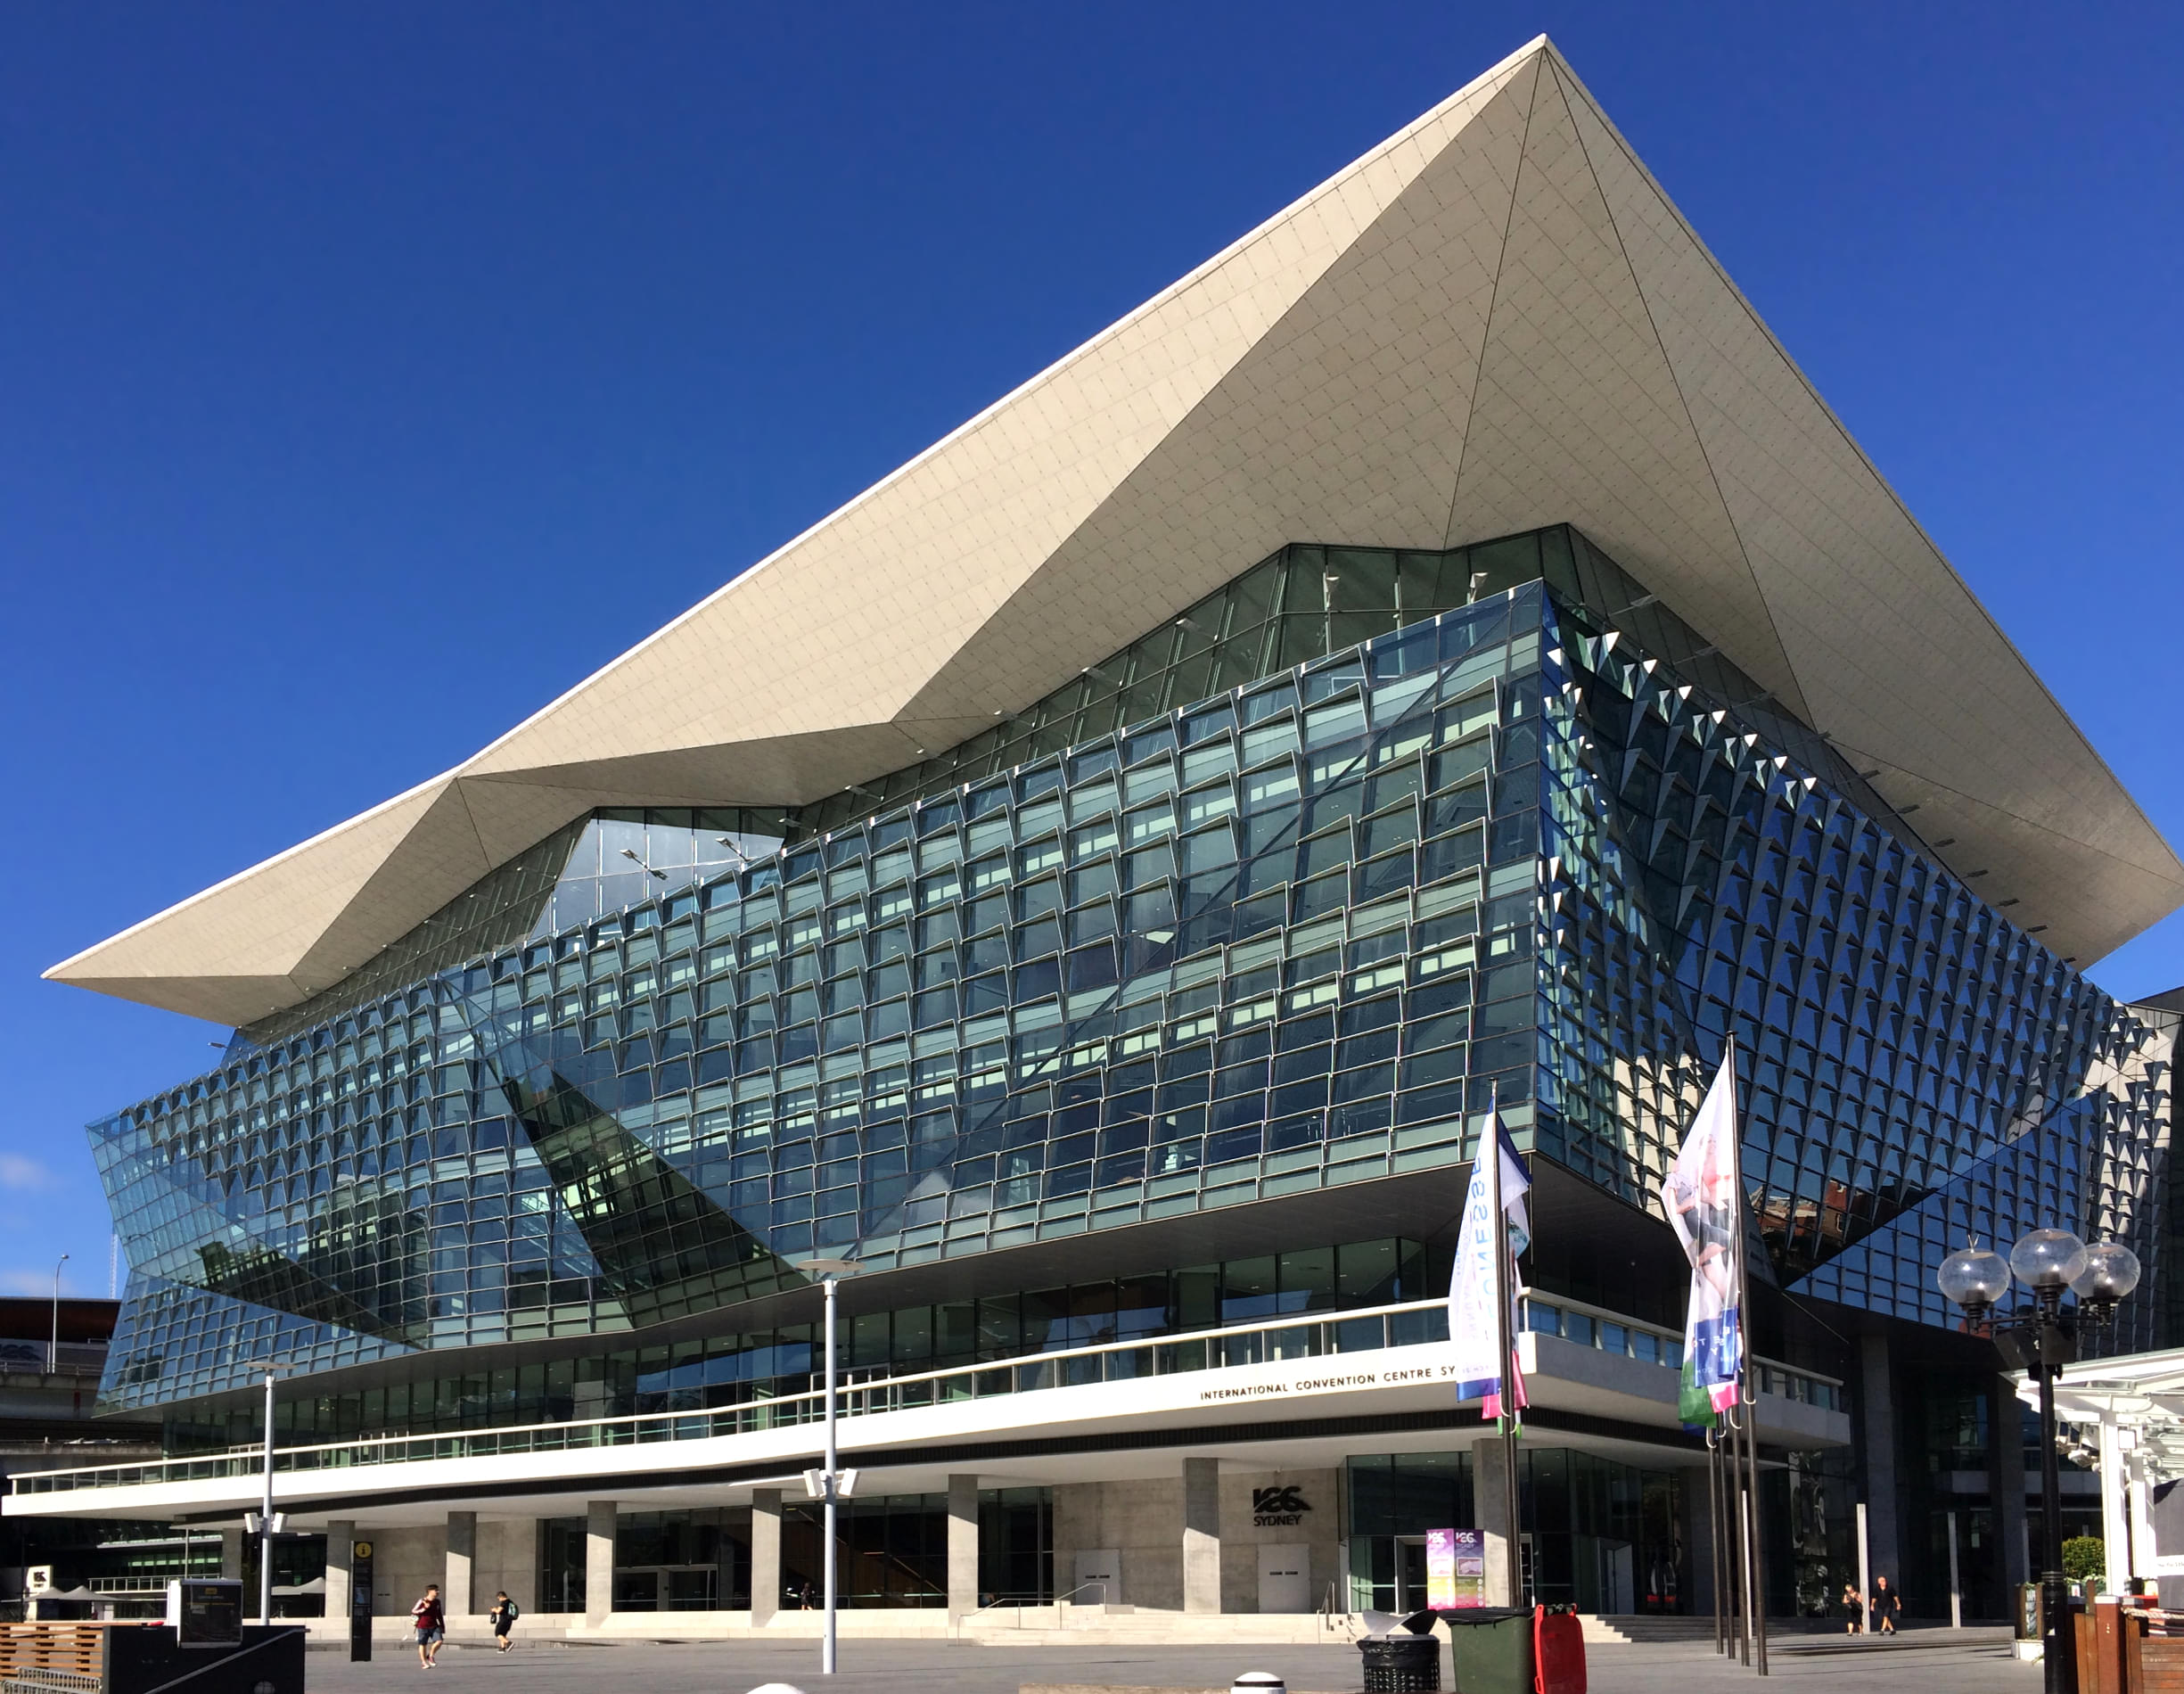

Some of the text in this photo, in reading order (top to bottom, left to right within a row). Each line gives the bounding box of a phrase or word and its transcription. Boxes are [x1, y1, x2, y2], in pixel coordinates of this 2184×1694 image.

[1201, 1384, 1288, 1400] INTERNATIONAL
[1296, 1374, 1375, 1391] CONVENTION
[1383, 1368, 1432, 1382] CENTRE
[1253, 1515, 1302, 1526] SYDNEY
